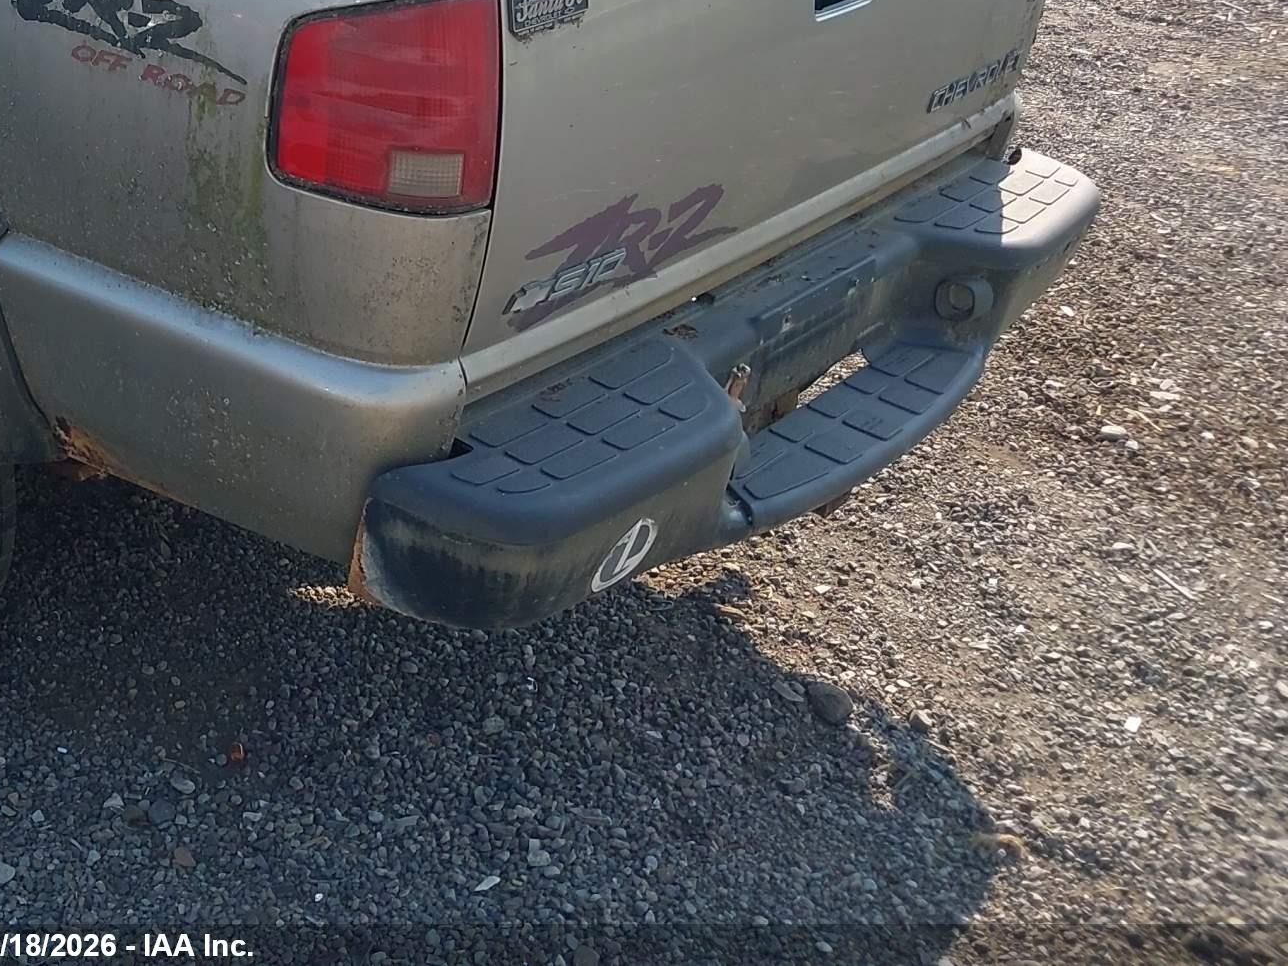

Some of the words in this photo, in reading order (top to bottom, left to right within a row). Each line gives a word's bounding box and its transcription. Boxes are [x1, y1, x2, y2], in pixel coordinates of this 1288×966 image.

[71, 43, 132, 71] OFF
[926, 46, 1023, 114] CHEVROLE
[548, 247, 627, 301] S10
